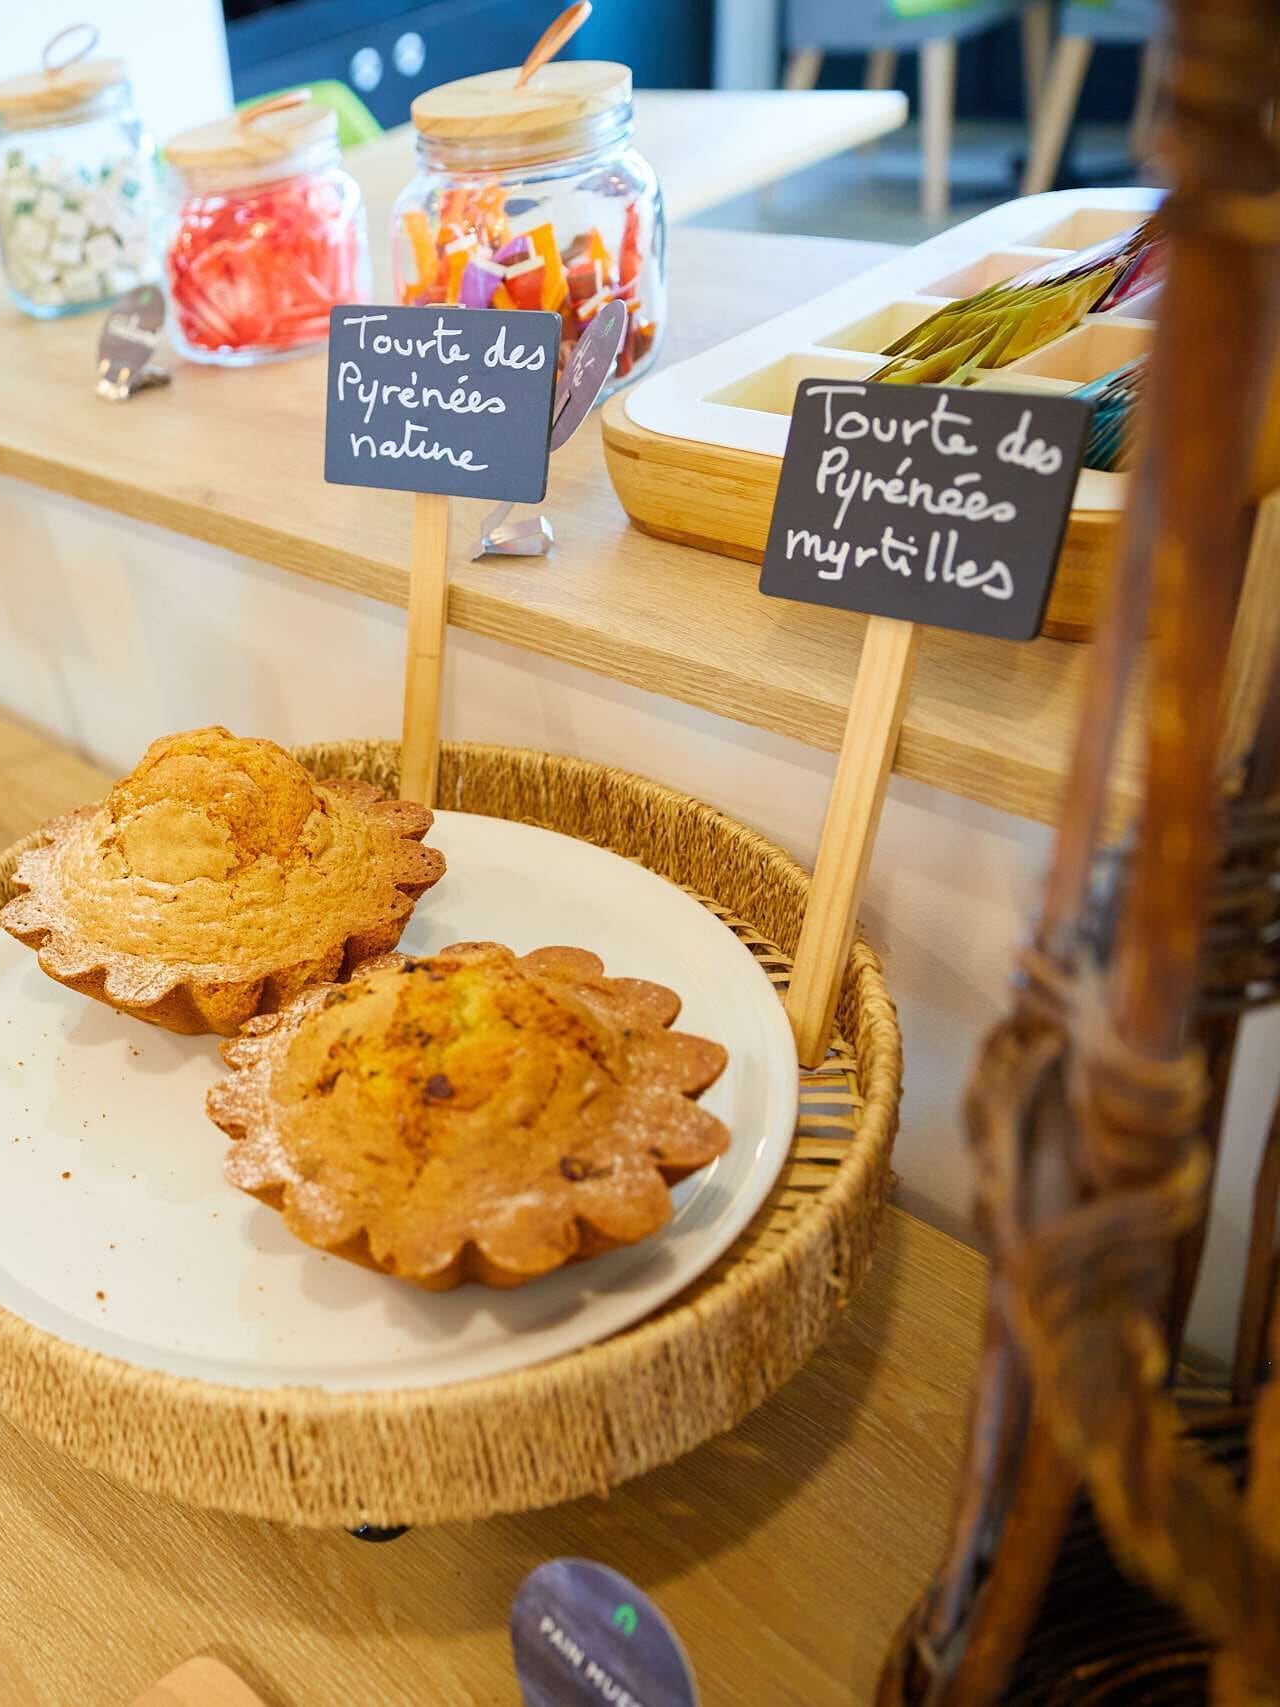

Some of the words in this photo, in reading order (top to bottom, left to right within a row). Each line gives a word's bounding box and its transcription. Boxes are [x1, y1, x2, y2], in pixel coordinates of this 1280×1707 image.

[343, 314, 470, 364] Tourte
[483, 326, 546, 371] des
[337, 361, 507, 424] Pyrénées
[806, 385, 978, 456] Tourte
[996, 410, 1063, 475] des
[816, 446, 1017, 530] Pyrénées
[786, 526, 1014, 600] myrtilles
[538, 1615, 585, 1668] PAIN
